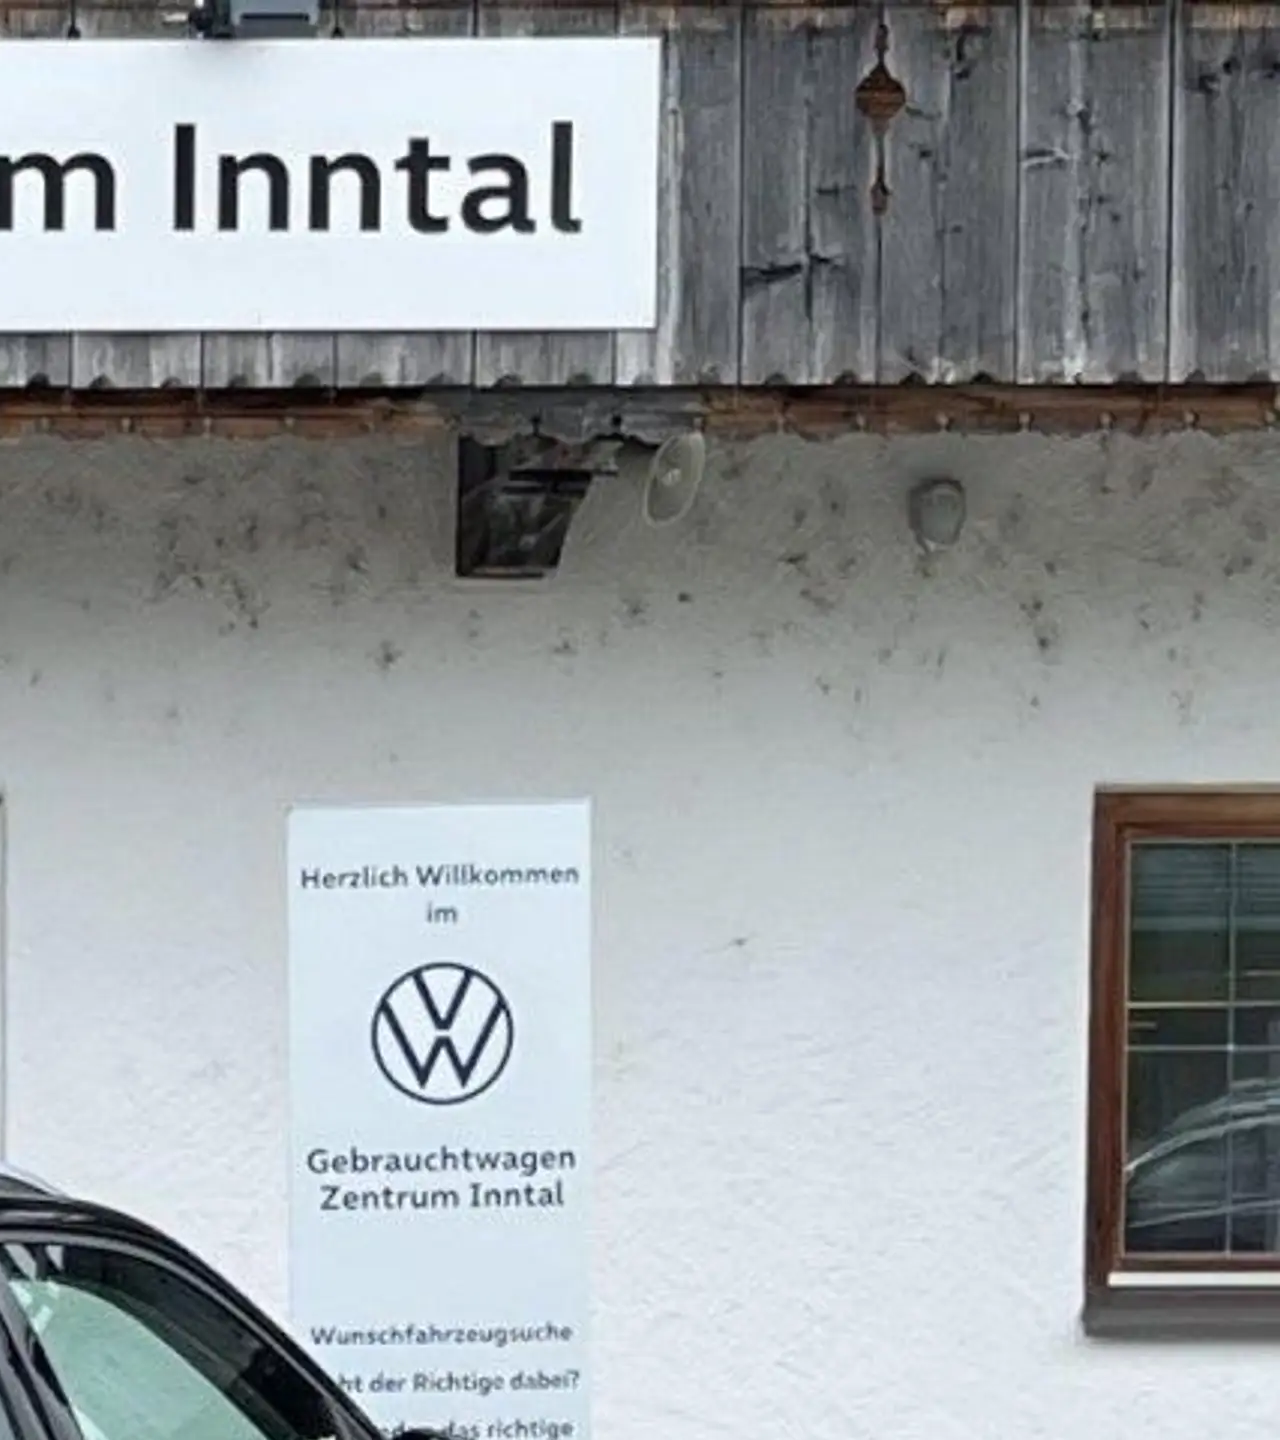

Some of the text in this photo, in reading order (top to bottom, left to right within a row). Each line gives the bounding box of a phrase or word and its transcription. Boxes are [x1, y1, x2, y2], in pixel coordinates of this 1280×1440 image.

[172, 120, 583, 235] Inntal
[300, 861, 580, 890] Herzlich Willkommen
[426, 902, 459, 924] im
[371, 962, 514, 1106] VW
[306, 1145, 577, 1178] Gebrauchtwagen
[320, 1180, 565, 1212] Zentrum Inntal
[310, 1321, 574, 1348] Wunschfahrzeugsuche
[369, 1370, 406, 1393] der
[412, 1371, 505, 1396] Richtige
[509, 1369, 581, 1392] dabei?
